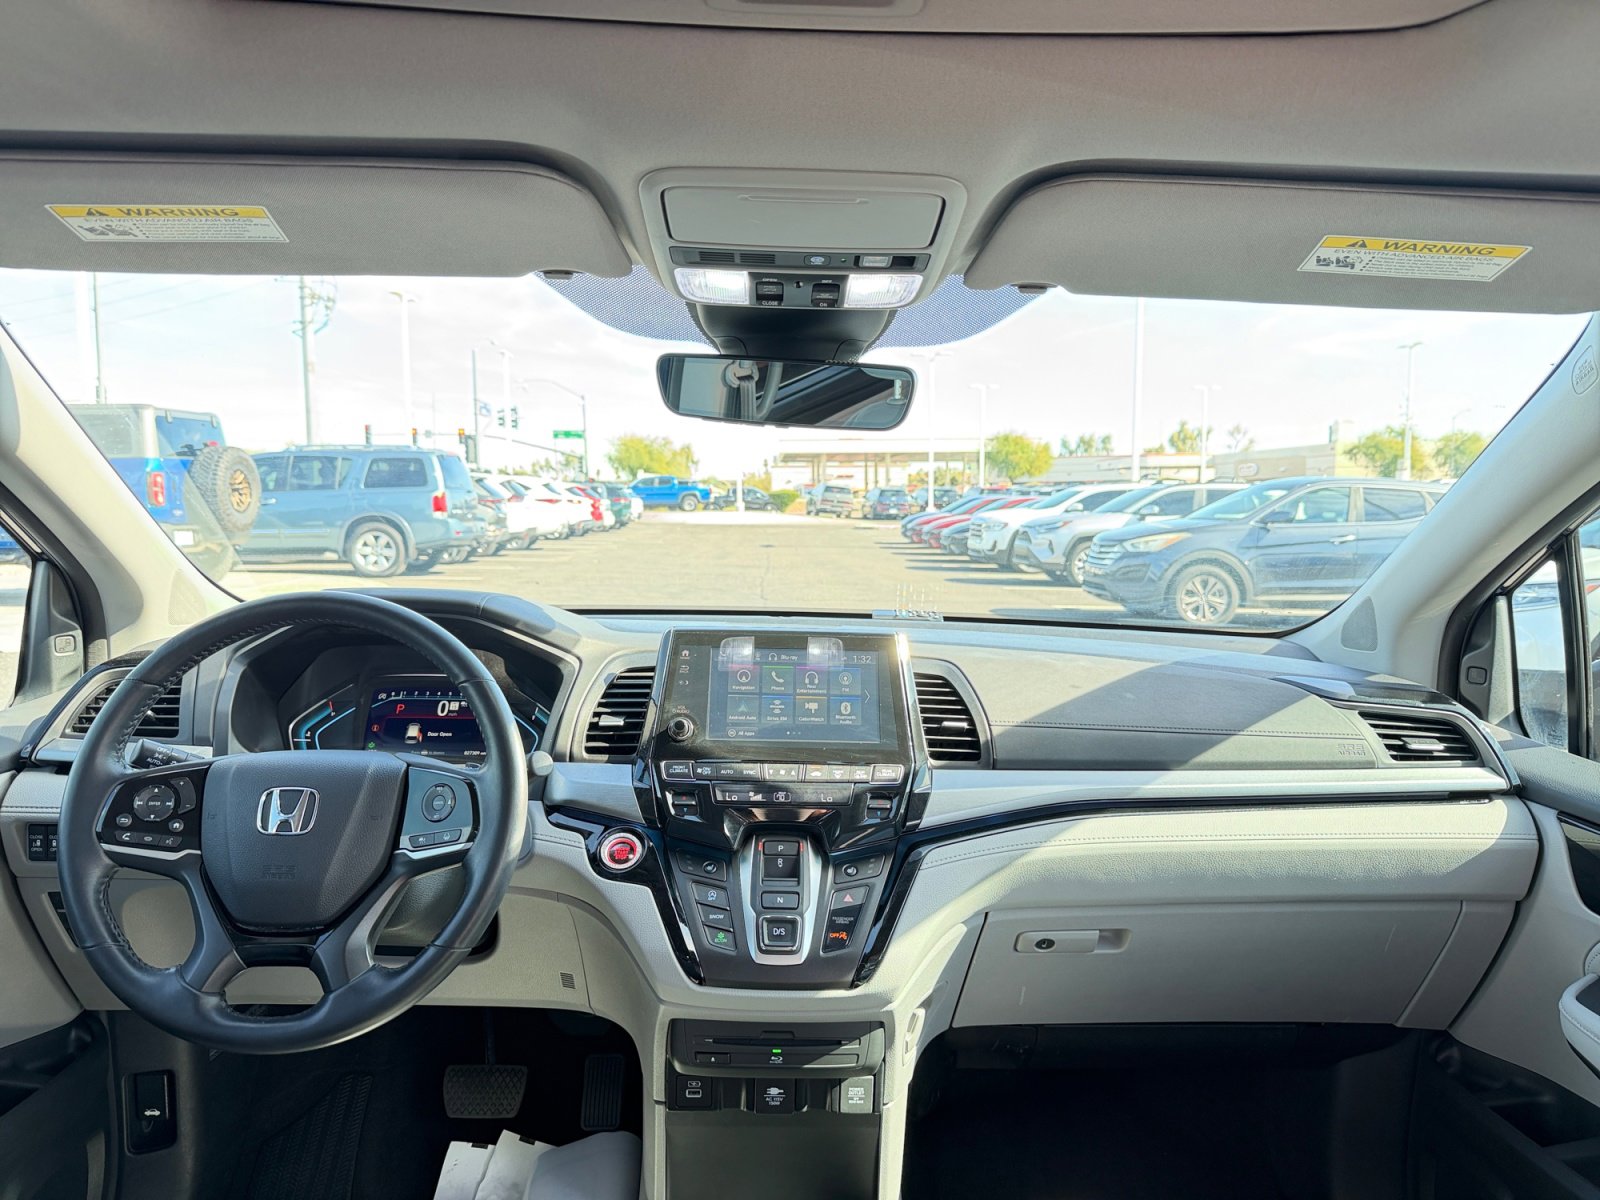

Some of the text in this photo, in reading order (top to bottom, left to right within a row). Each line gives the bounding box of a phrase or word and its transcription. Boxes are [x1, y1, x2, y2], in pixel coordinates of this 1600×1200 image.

[118, 207, 239, 217] WARNING
[1383, 241, 1497, 256] WARNING
[853, 655, 872, 664] 1:32
[396, 703, 405, 714] P
[437, 700, 449, 717] 0
[777, 896, 784, 904] N
[772, 927, 786, 936] D/S
